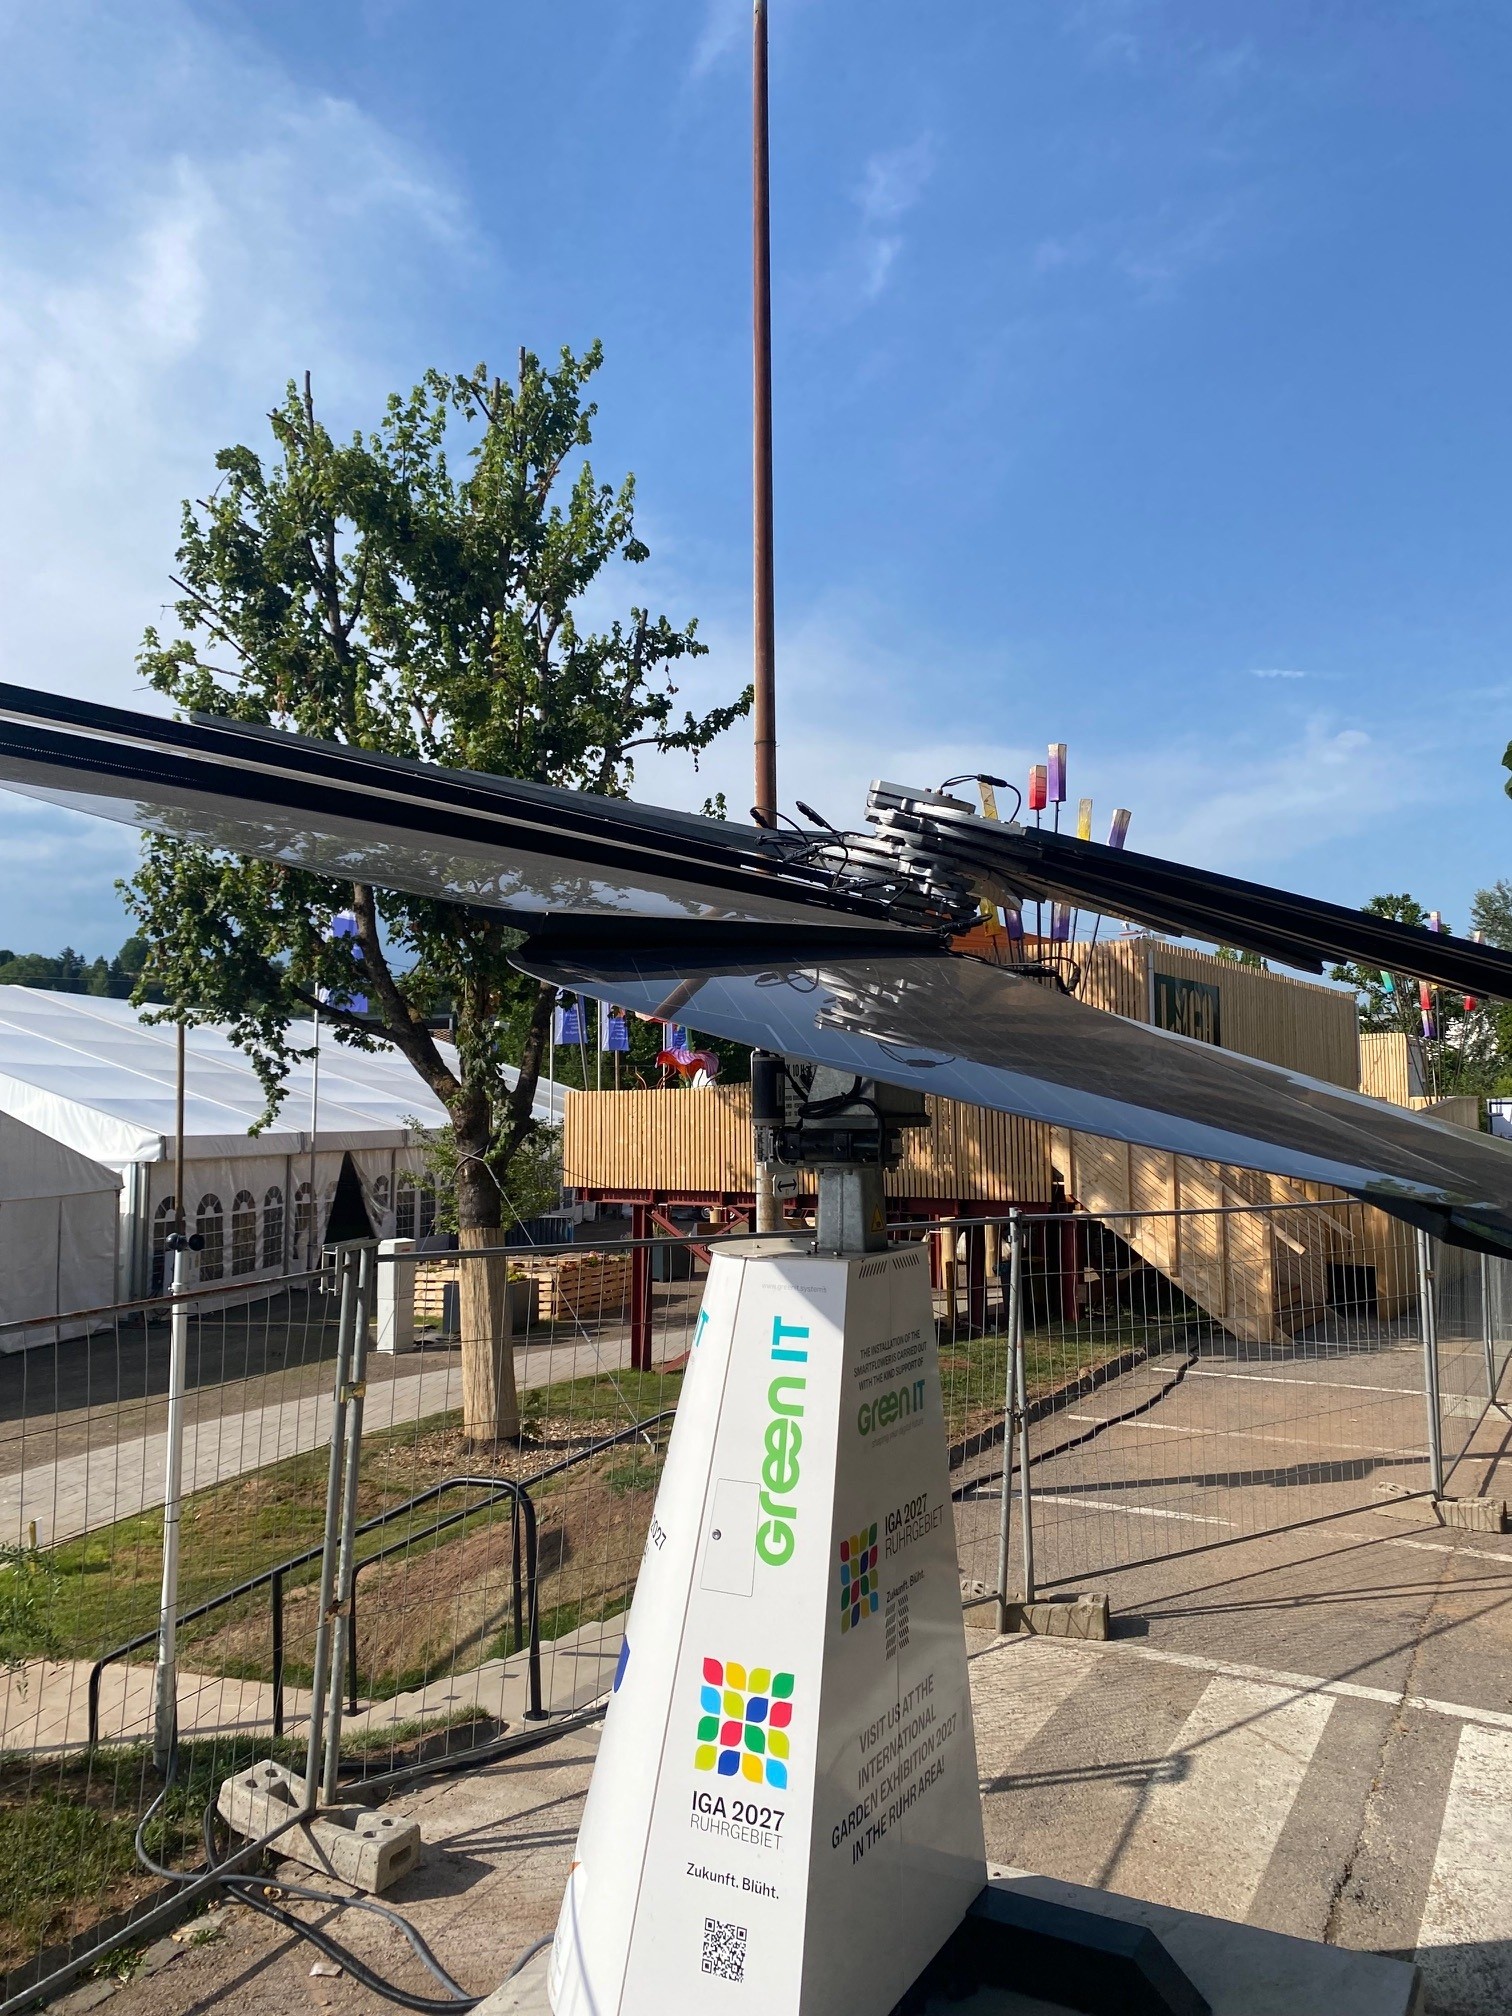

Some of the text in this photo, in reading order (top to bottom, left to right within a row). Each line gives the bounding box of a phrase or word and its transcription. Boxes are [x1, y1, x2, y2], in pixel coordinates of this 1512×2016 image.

[853, 1354, 892, 1378] SMARTFLOWER
[897, 1345, 918, 1361] CARRIED
[918, 1341, 927, 1353] OUT
[860, 1329, 921, 1359] THE INSTALLATION OF THE
[858, 1357, 924, 1391] WITH THE KIND SUPPORT OF
[858, 1379, 925, 1436] Green IT
[756, 1316, 809, 1567] Green IT
[885, 1493, 928, 1536] IGA 2027
[885, 1504, 944, 1559] RUHRGEBIET
[886, 1580, 909, 1603] Zukunft.
[859, 1673, 934, 1754] VISIT US AT THE
[858, 1703, 937, 1790] INTERNATIONAL
[831, 1712, 957, 1849] GARDEN EXHIBITION 2027
[692, 1790, 785, 1831] IGA 2027
[852, 1754, 945, 1865] IN THE RUHR AREA!
[690, 1813, 783, 1850] RUHRGEBIET
[686, 1862, 779, 1899] Zukunft. Blüht.
